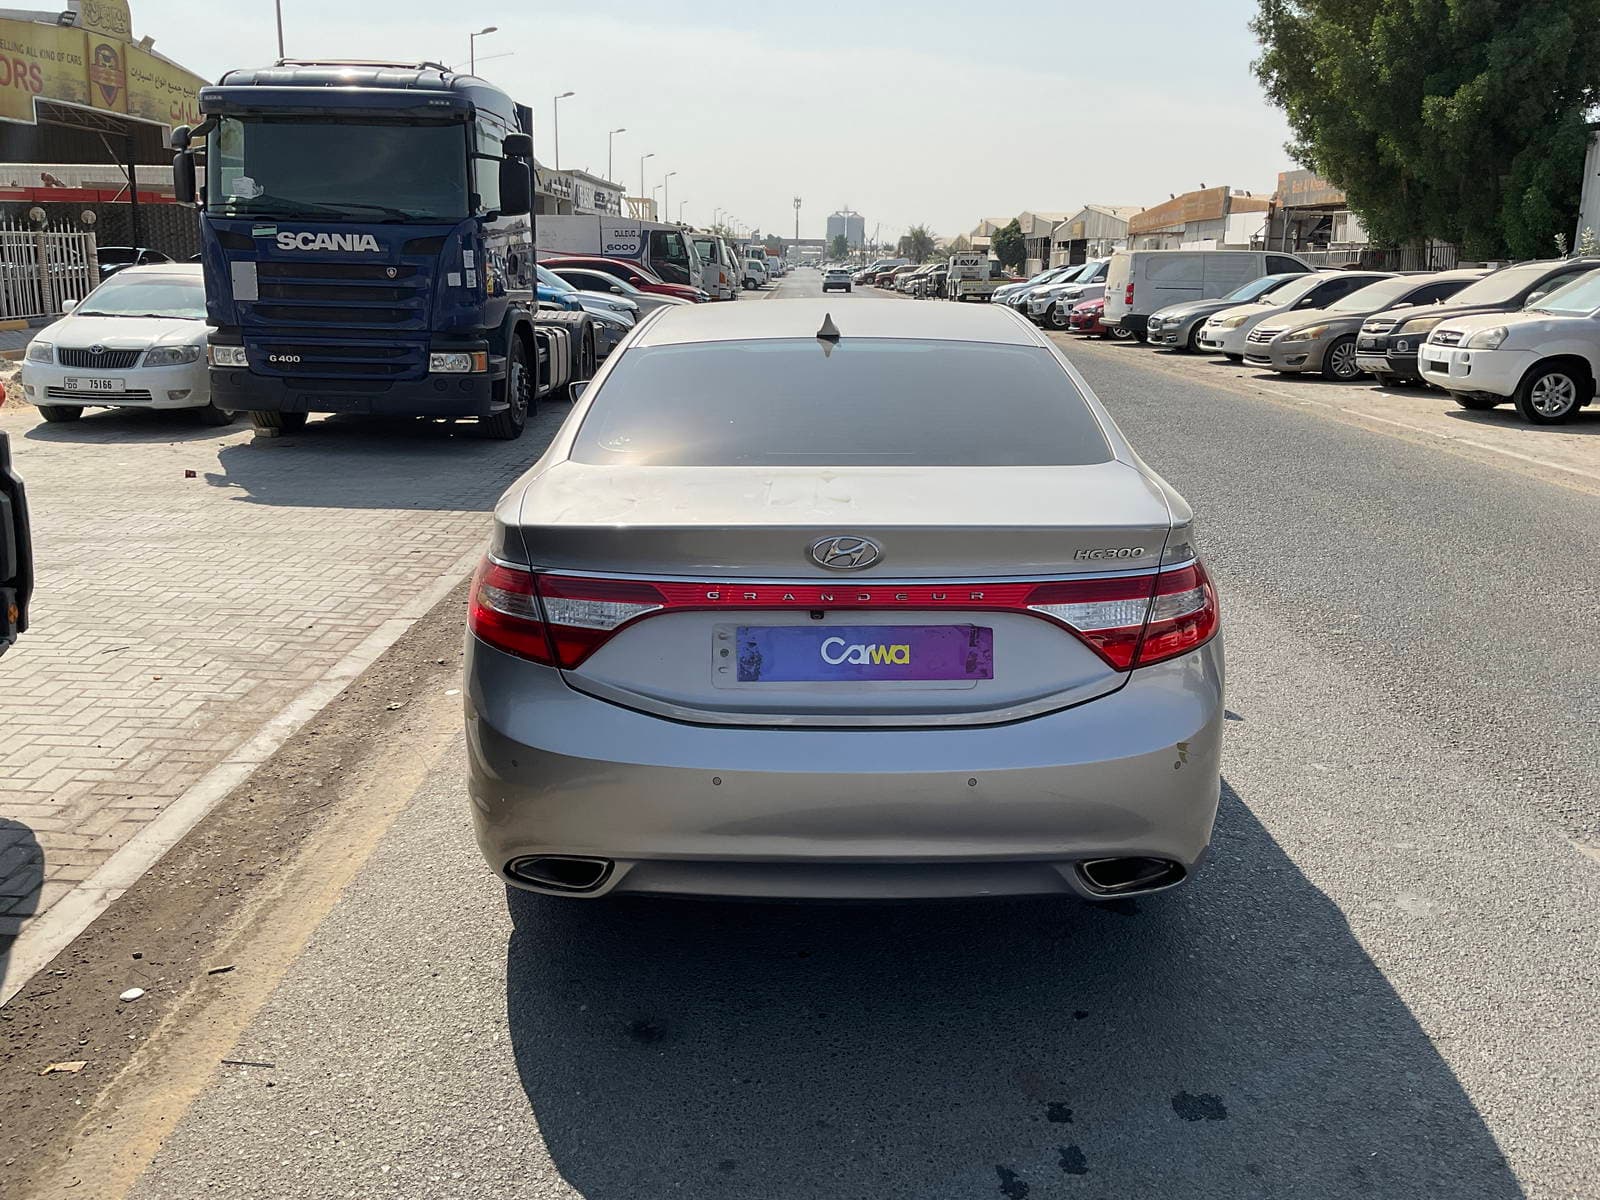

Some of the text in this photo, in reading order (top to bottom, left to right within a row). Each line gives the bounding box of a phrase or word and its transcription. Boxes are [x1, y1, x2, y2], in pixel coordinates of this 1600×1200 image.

[26, 46, 38, 57] ALL
[40, 48, 55, 61] KIND
[57, 52, 64, 62] OF
[66, 54, 82, 66] CARS
[276, 232, 380, 252] SCANIA
[89, 379, 112, 389] 75166
[706, 590, 985, 602] GRANDEUR
[820, 636, 910, 666] Carwa
